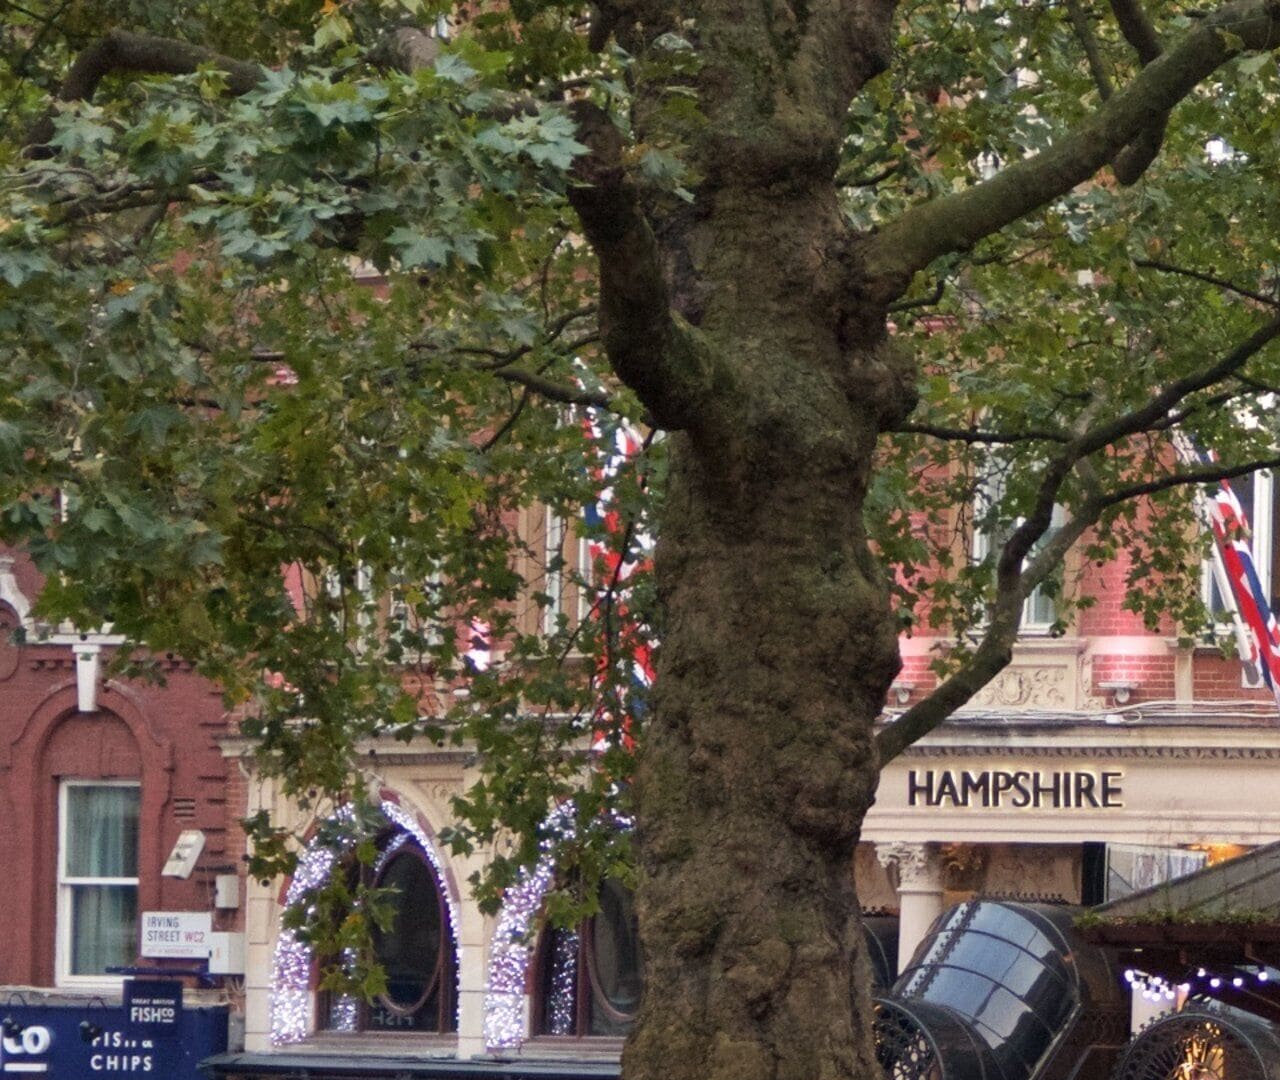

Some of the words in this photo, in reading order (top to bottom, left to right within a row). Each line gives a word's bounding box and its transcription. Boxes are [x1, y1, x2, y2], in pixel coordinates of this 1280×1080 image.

[908, 770, 1123, 808] HAMPSHIRE
[147, 916, 180, 928] IRVING
[147, 930, 180, 942] STREET
[184, 931, 205, 943] WC2
[90, 1054, 153, 1071] CHIPS
